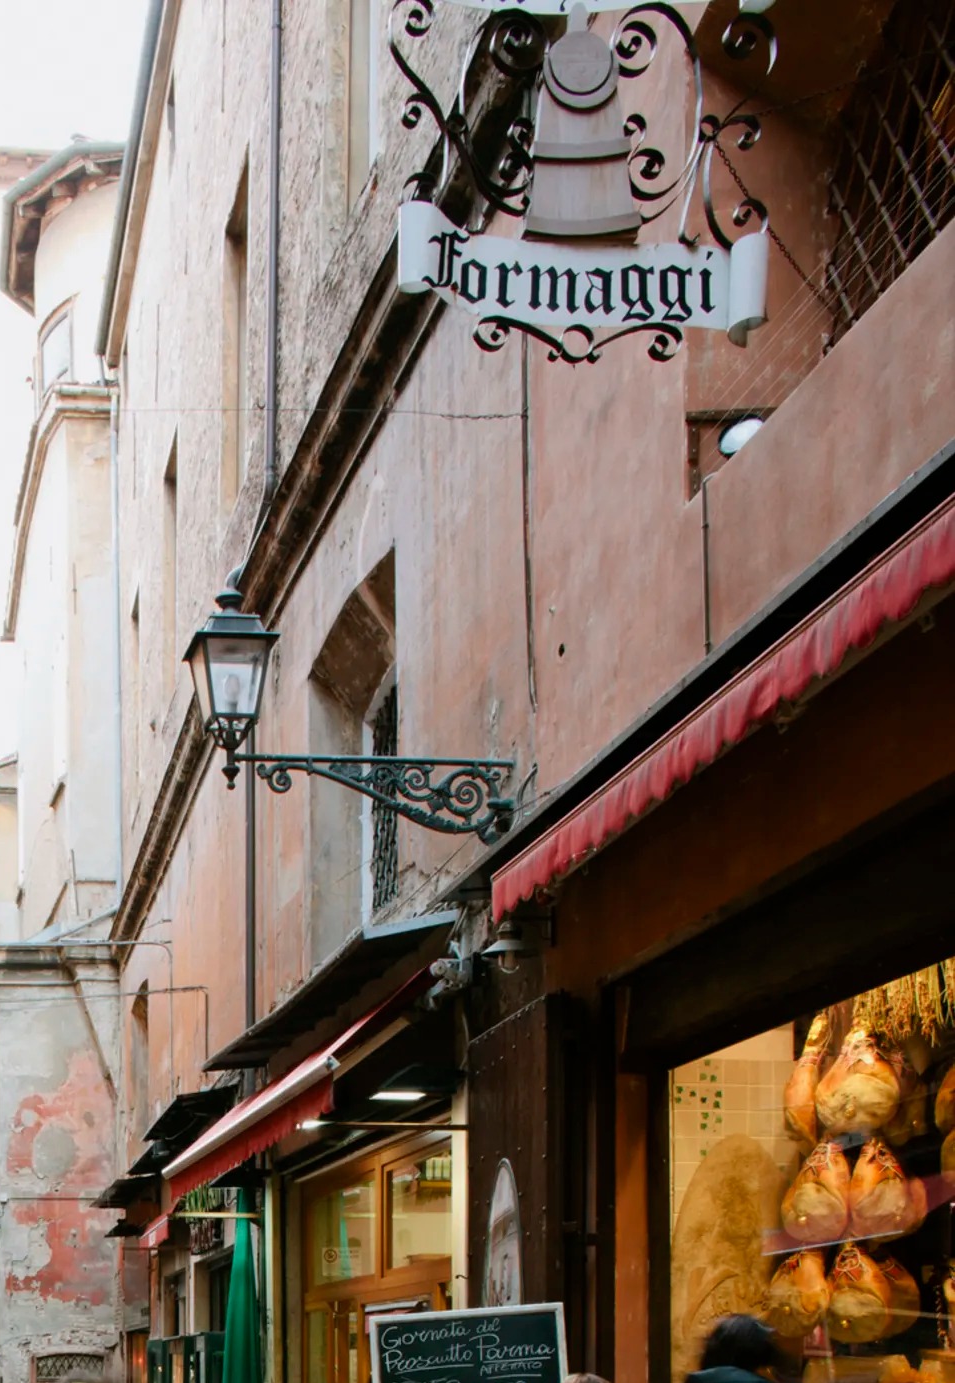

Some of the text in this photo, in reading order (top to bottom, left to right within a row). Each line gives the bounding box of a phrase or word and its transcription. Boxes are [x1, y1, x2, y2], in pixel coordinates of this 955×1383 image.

[421, 228, 716, 323] Formaggi
[476, 1317, 502, 1333] del
[469, 1333, 556, 1362] Parma
